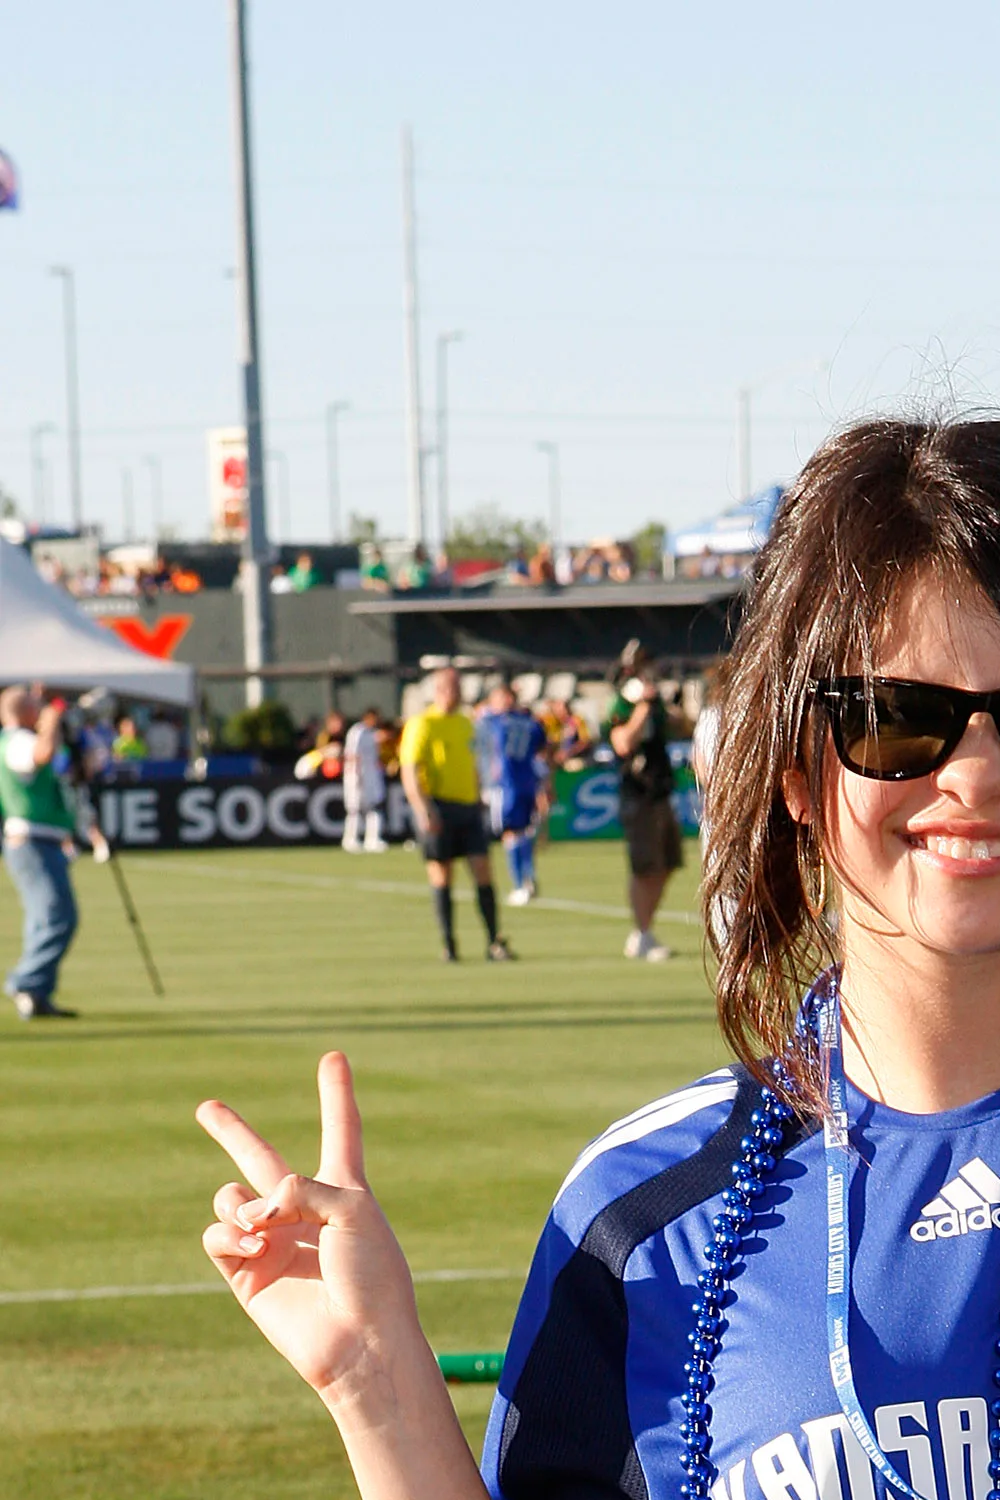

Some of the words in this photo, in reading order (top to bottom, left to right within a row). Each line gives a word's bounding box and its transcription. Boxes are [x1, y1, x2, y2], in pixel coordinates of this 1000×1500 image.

[827, 1173, 844, 1229] WIZARDS
[828, 1224, 844, 1257] CITY
[827, 1253, 844, 1295] KANSAS
[834, 1316, 844, 1348] BANK
